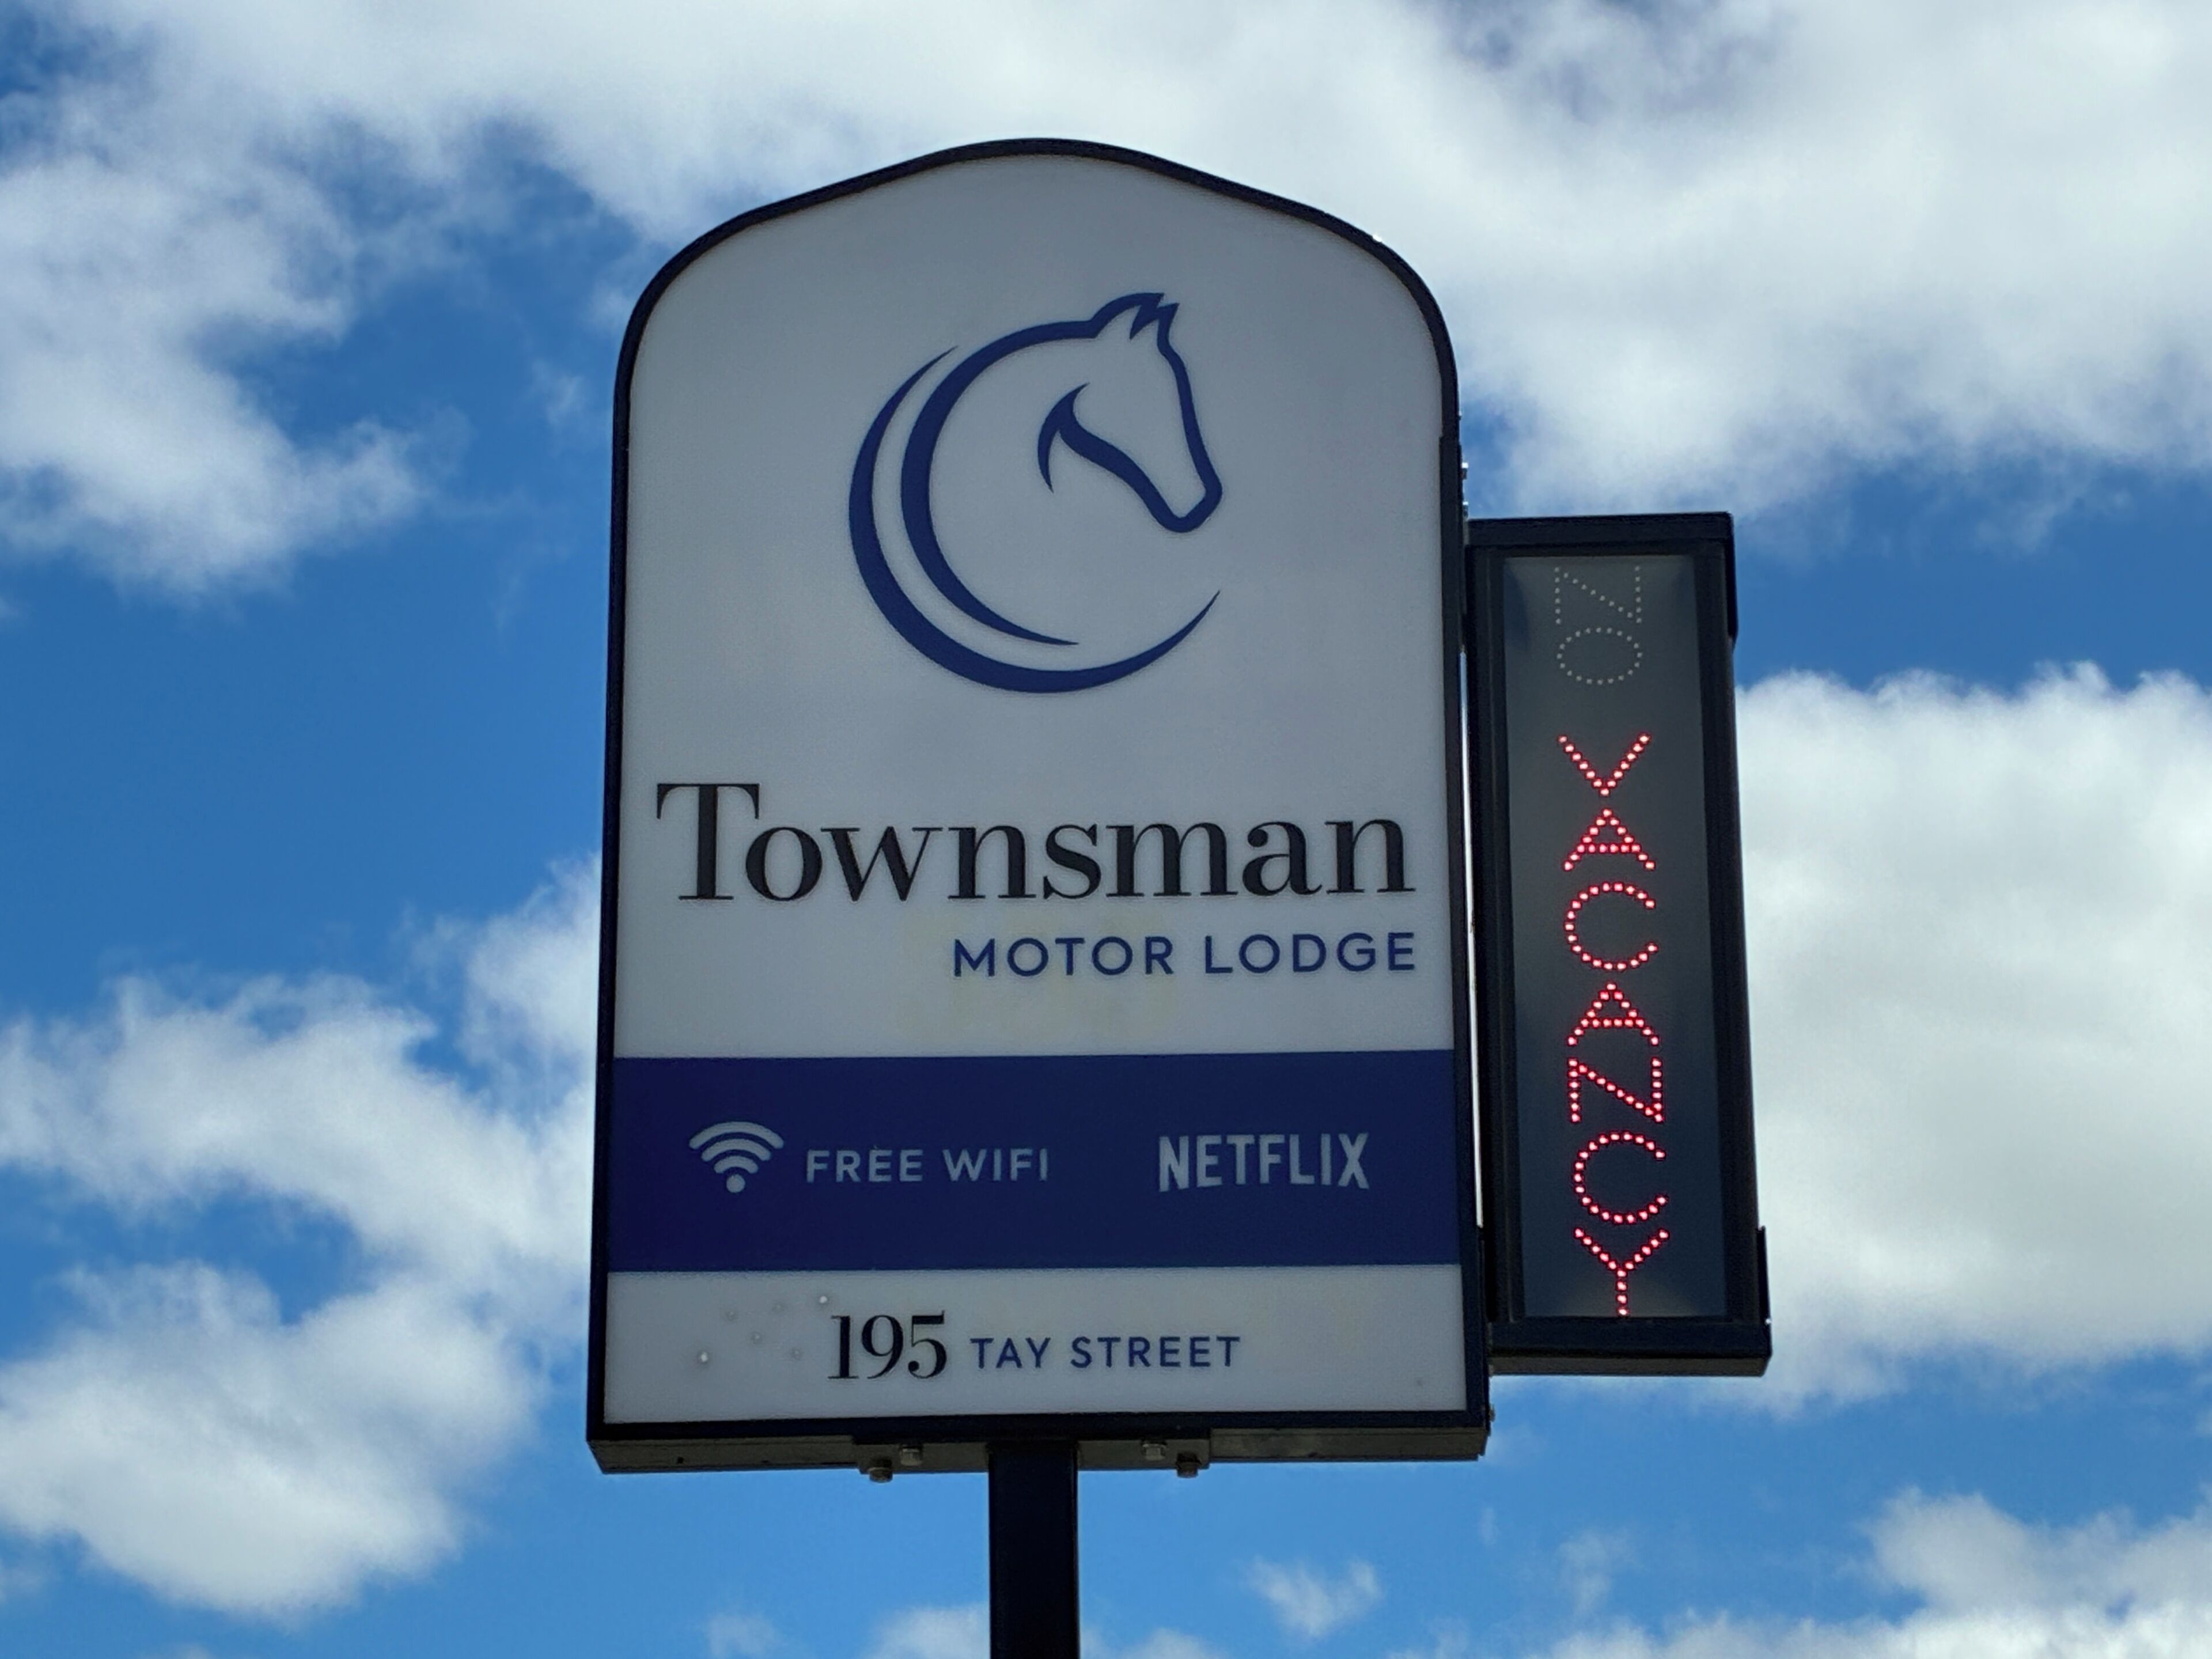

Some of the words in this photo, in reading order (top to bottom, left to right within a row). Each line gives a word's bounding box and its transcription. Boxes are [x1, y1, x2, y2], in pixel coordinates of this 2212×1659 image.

[1554, 566, 1643, 685] NO
[657, 782, 1415, 902] Townsman
[953, 935, 1173, 978] MOTOR
[1205, 931, 1416, 974] LODGE
[1557, 733, 1671, 1318] VACANCY
[806, 1148, 923, 1183] FREE
[942, 1147, 1049, 1181] WIFI
[1158, 1132, 1370, 1193] NETFLIX
[828, 1309, 948, 1380] 195
[969, 1336, 1052, 1369] TAY
[1070, 1335, 1242, 1368] STREET
